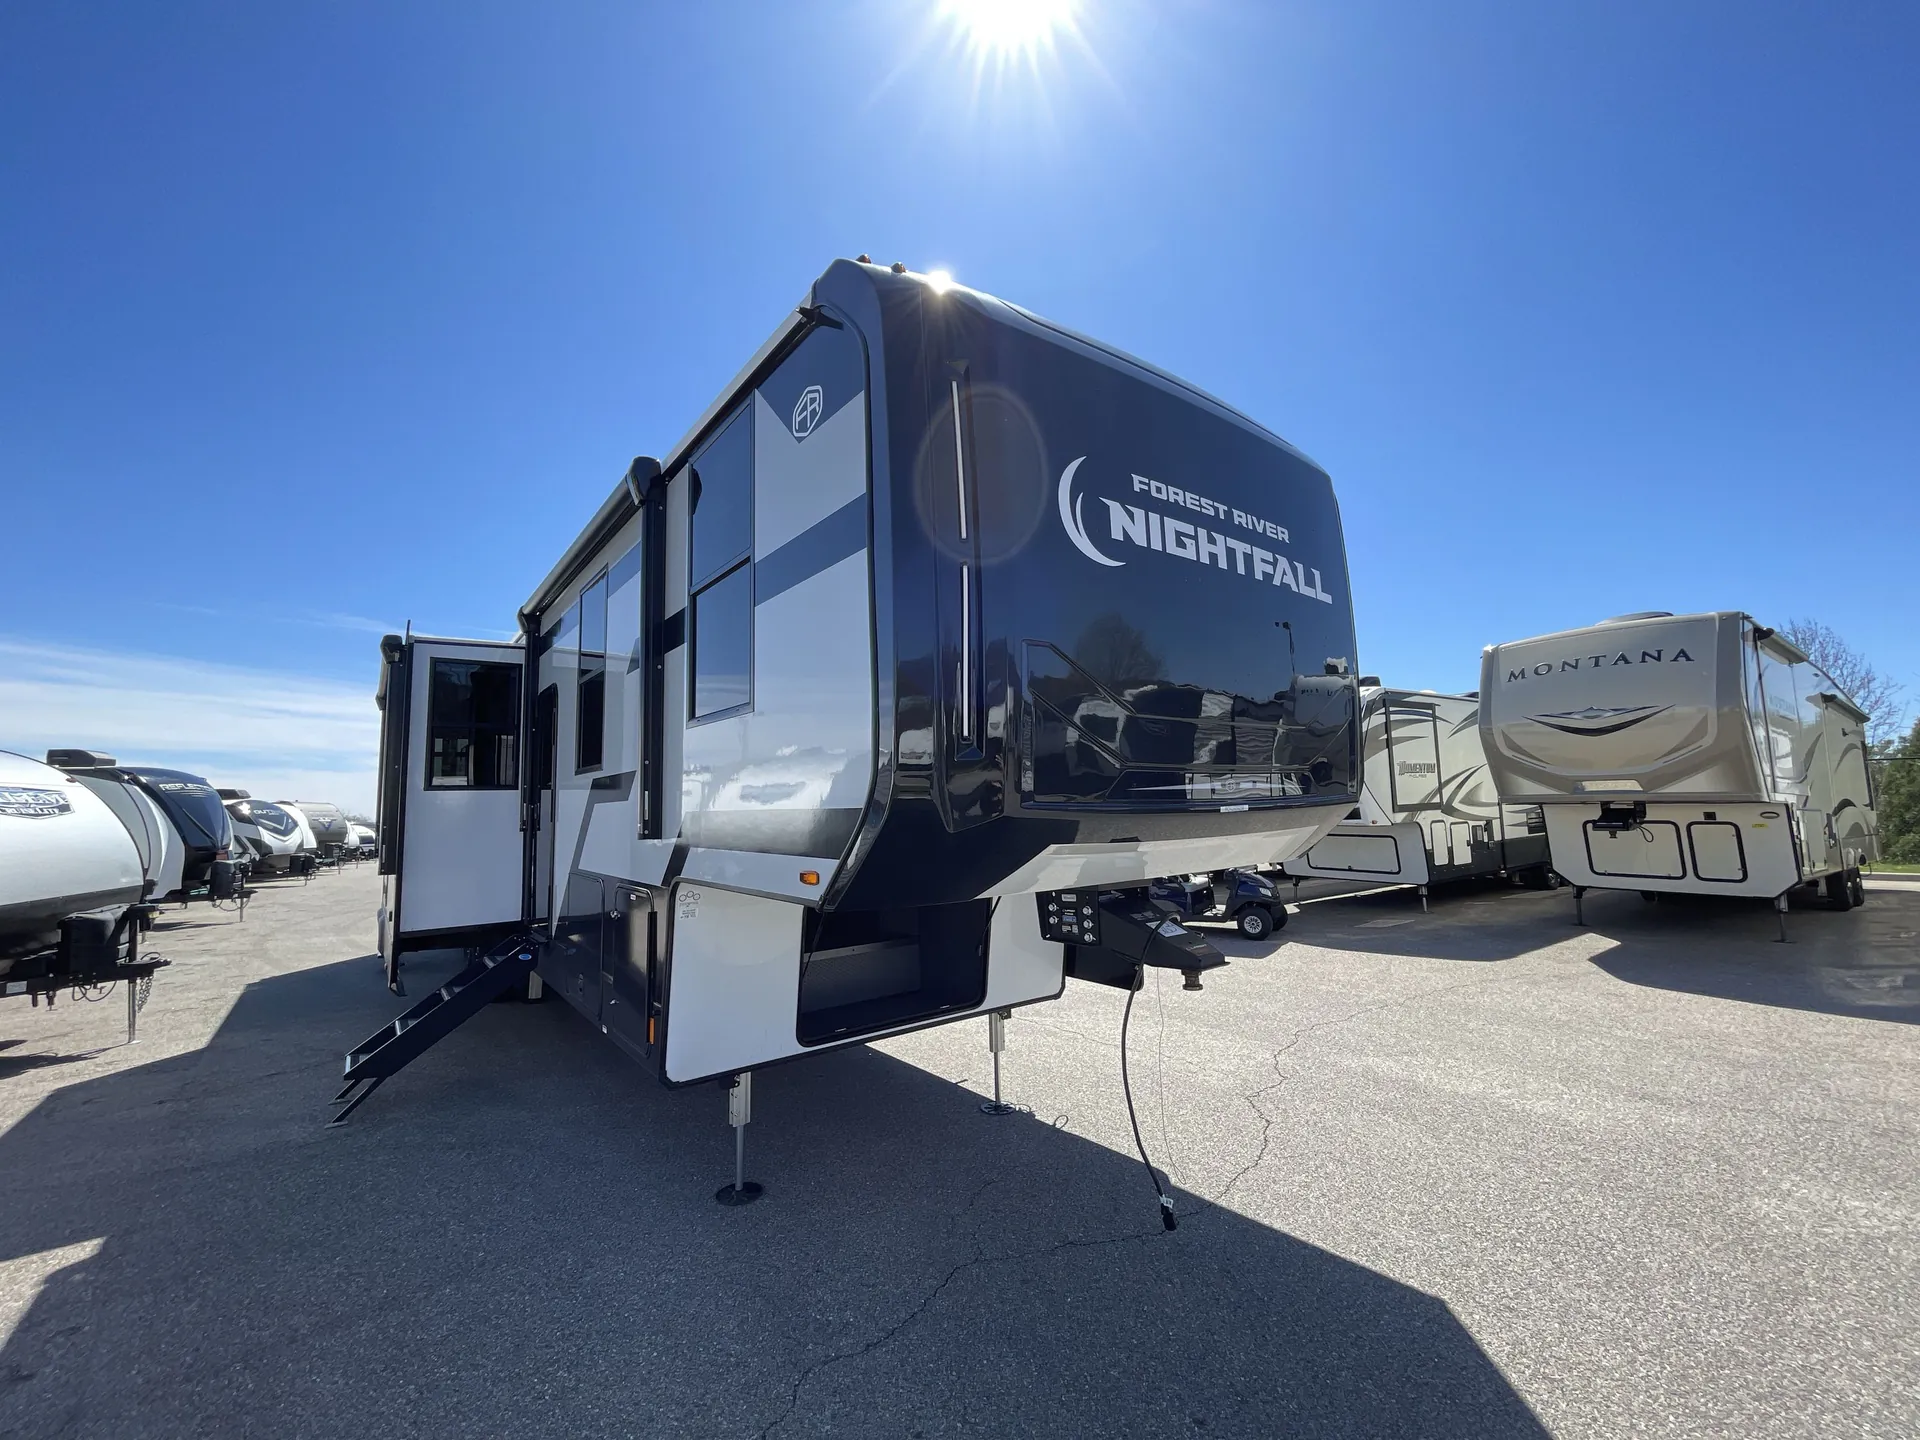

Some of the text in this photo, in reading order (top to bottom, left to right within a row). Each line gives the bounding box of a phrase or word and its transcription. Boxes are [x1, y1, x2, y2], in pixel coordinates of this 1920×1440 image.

[1131, 473, 1290, 543] FOREST RIVER
[1099, 496, 1333, 604] NIGHTFALL
[1507, 648, 1695, 683] MONTANA
